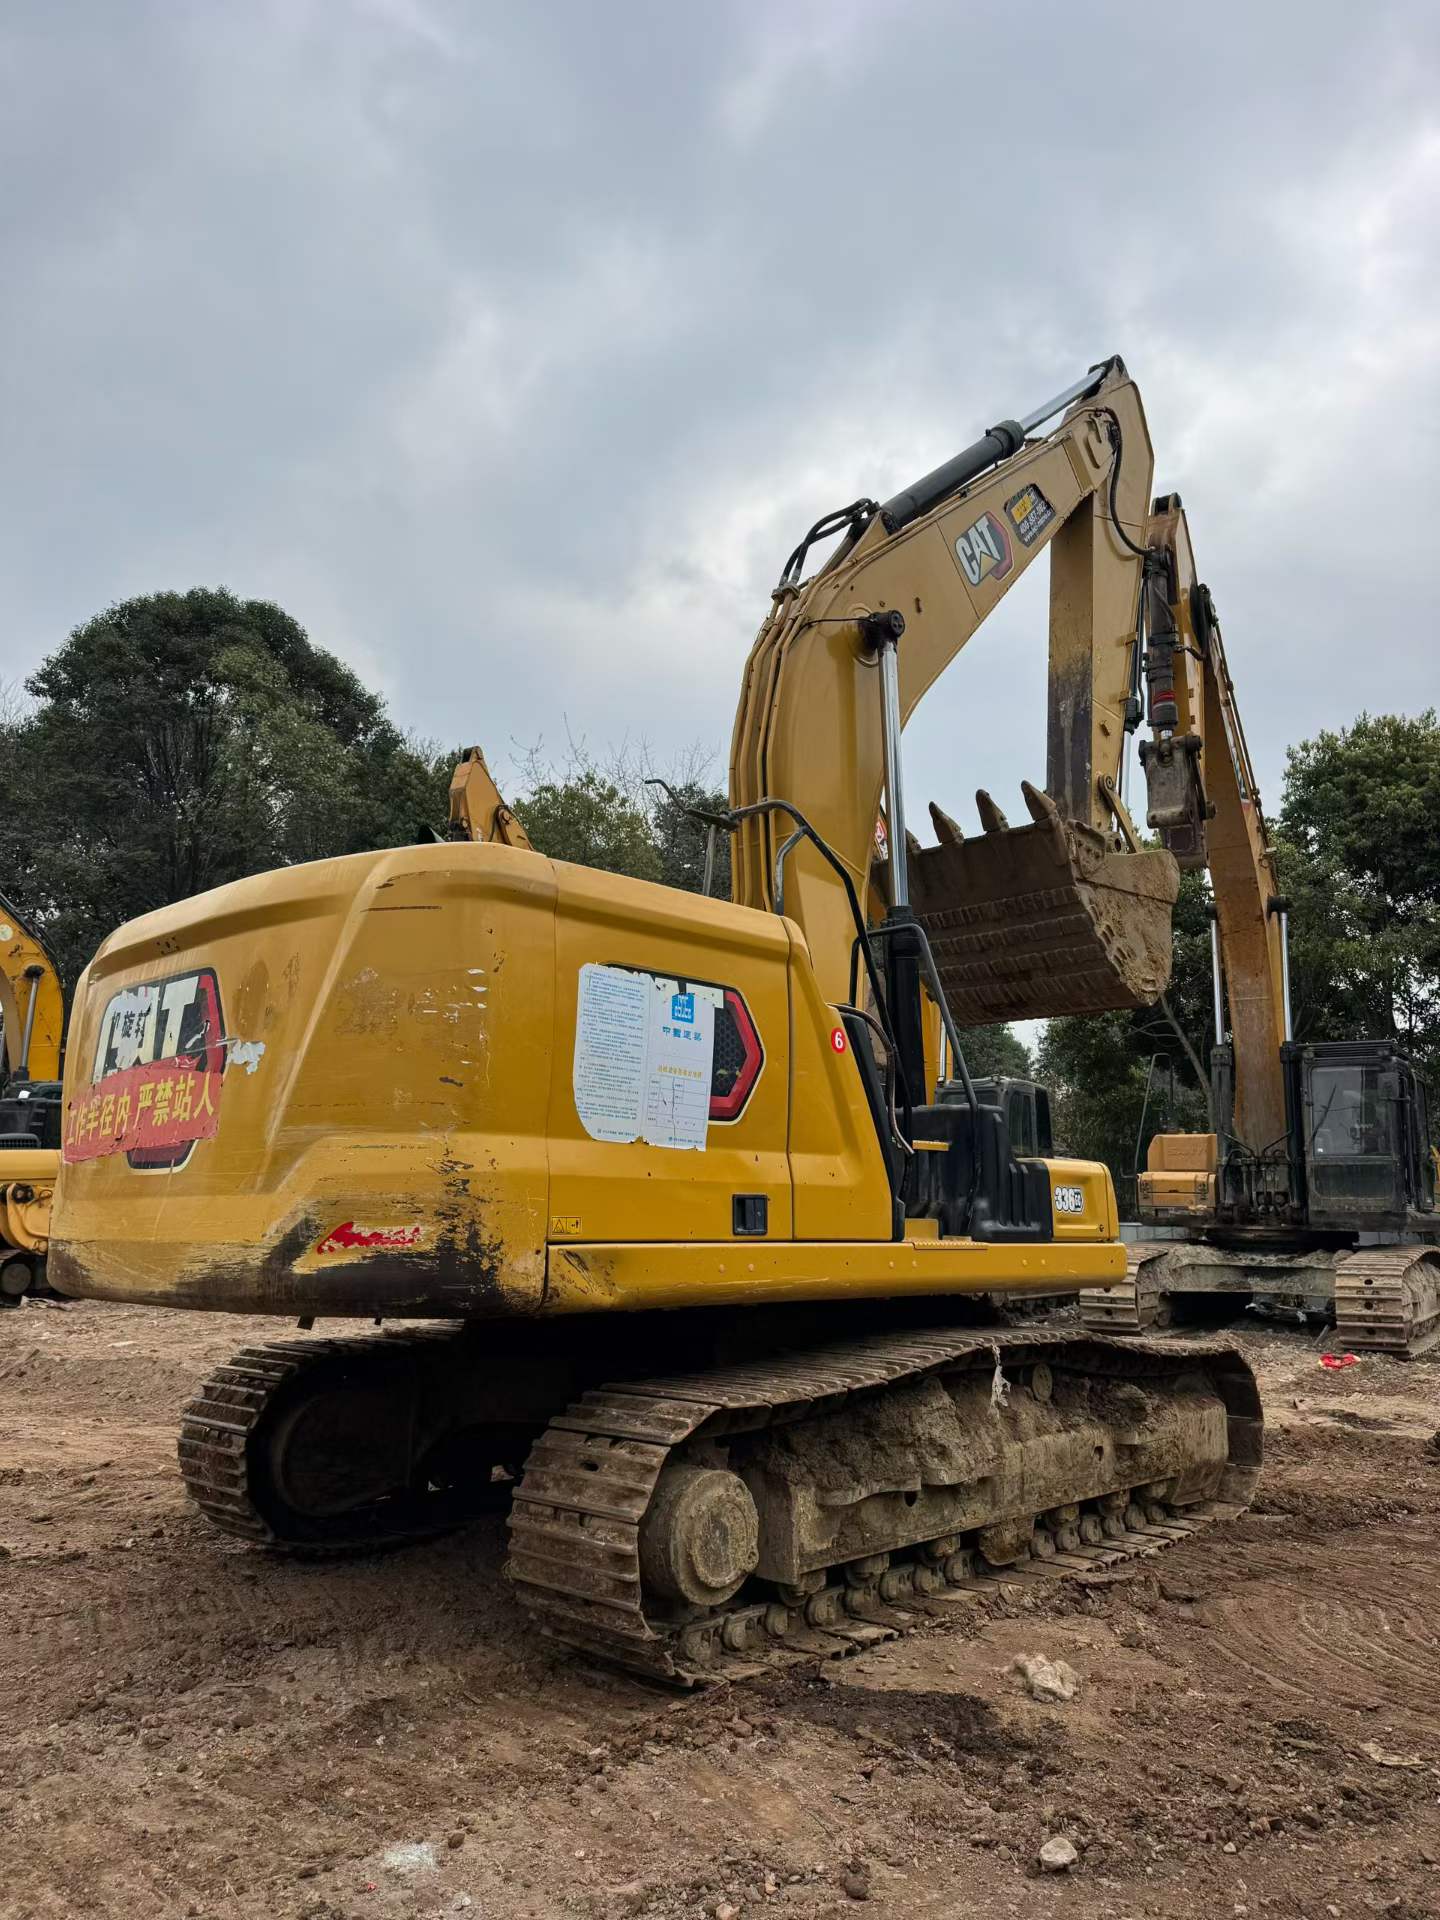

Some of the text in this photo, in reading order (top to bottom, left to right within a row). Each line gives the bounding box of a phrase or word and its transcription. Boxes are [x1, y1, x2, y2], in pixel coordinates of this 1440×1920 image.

[955, 514, 1001, 585] CAT
[834, 1031, 844, 1049] 6
[66, 1071, 214, 1146] 工作半径内 严禁站人
